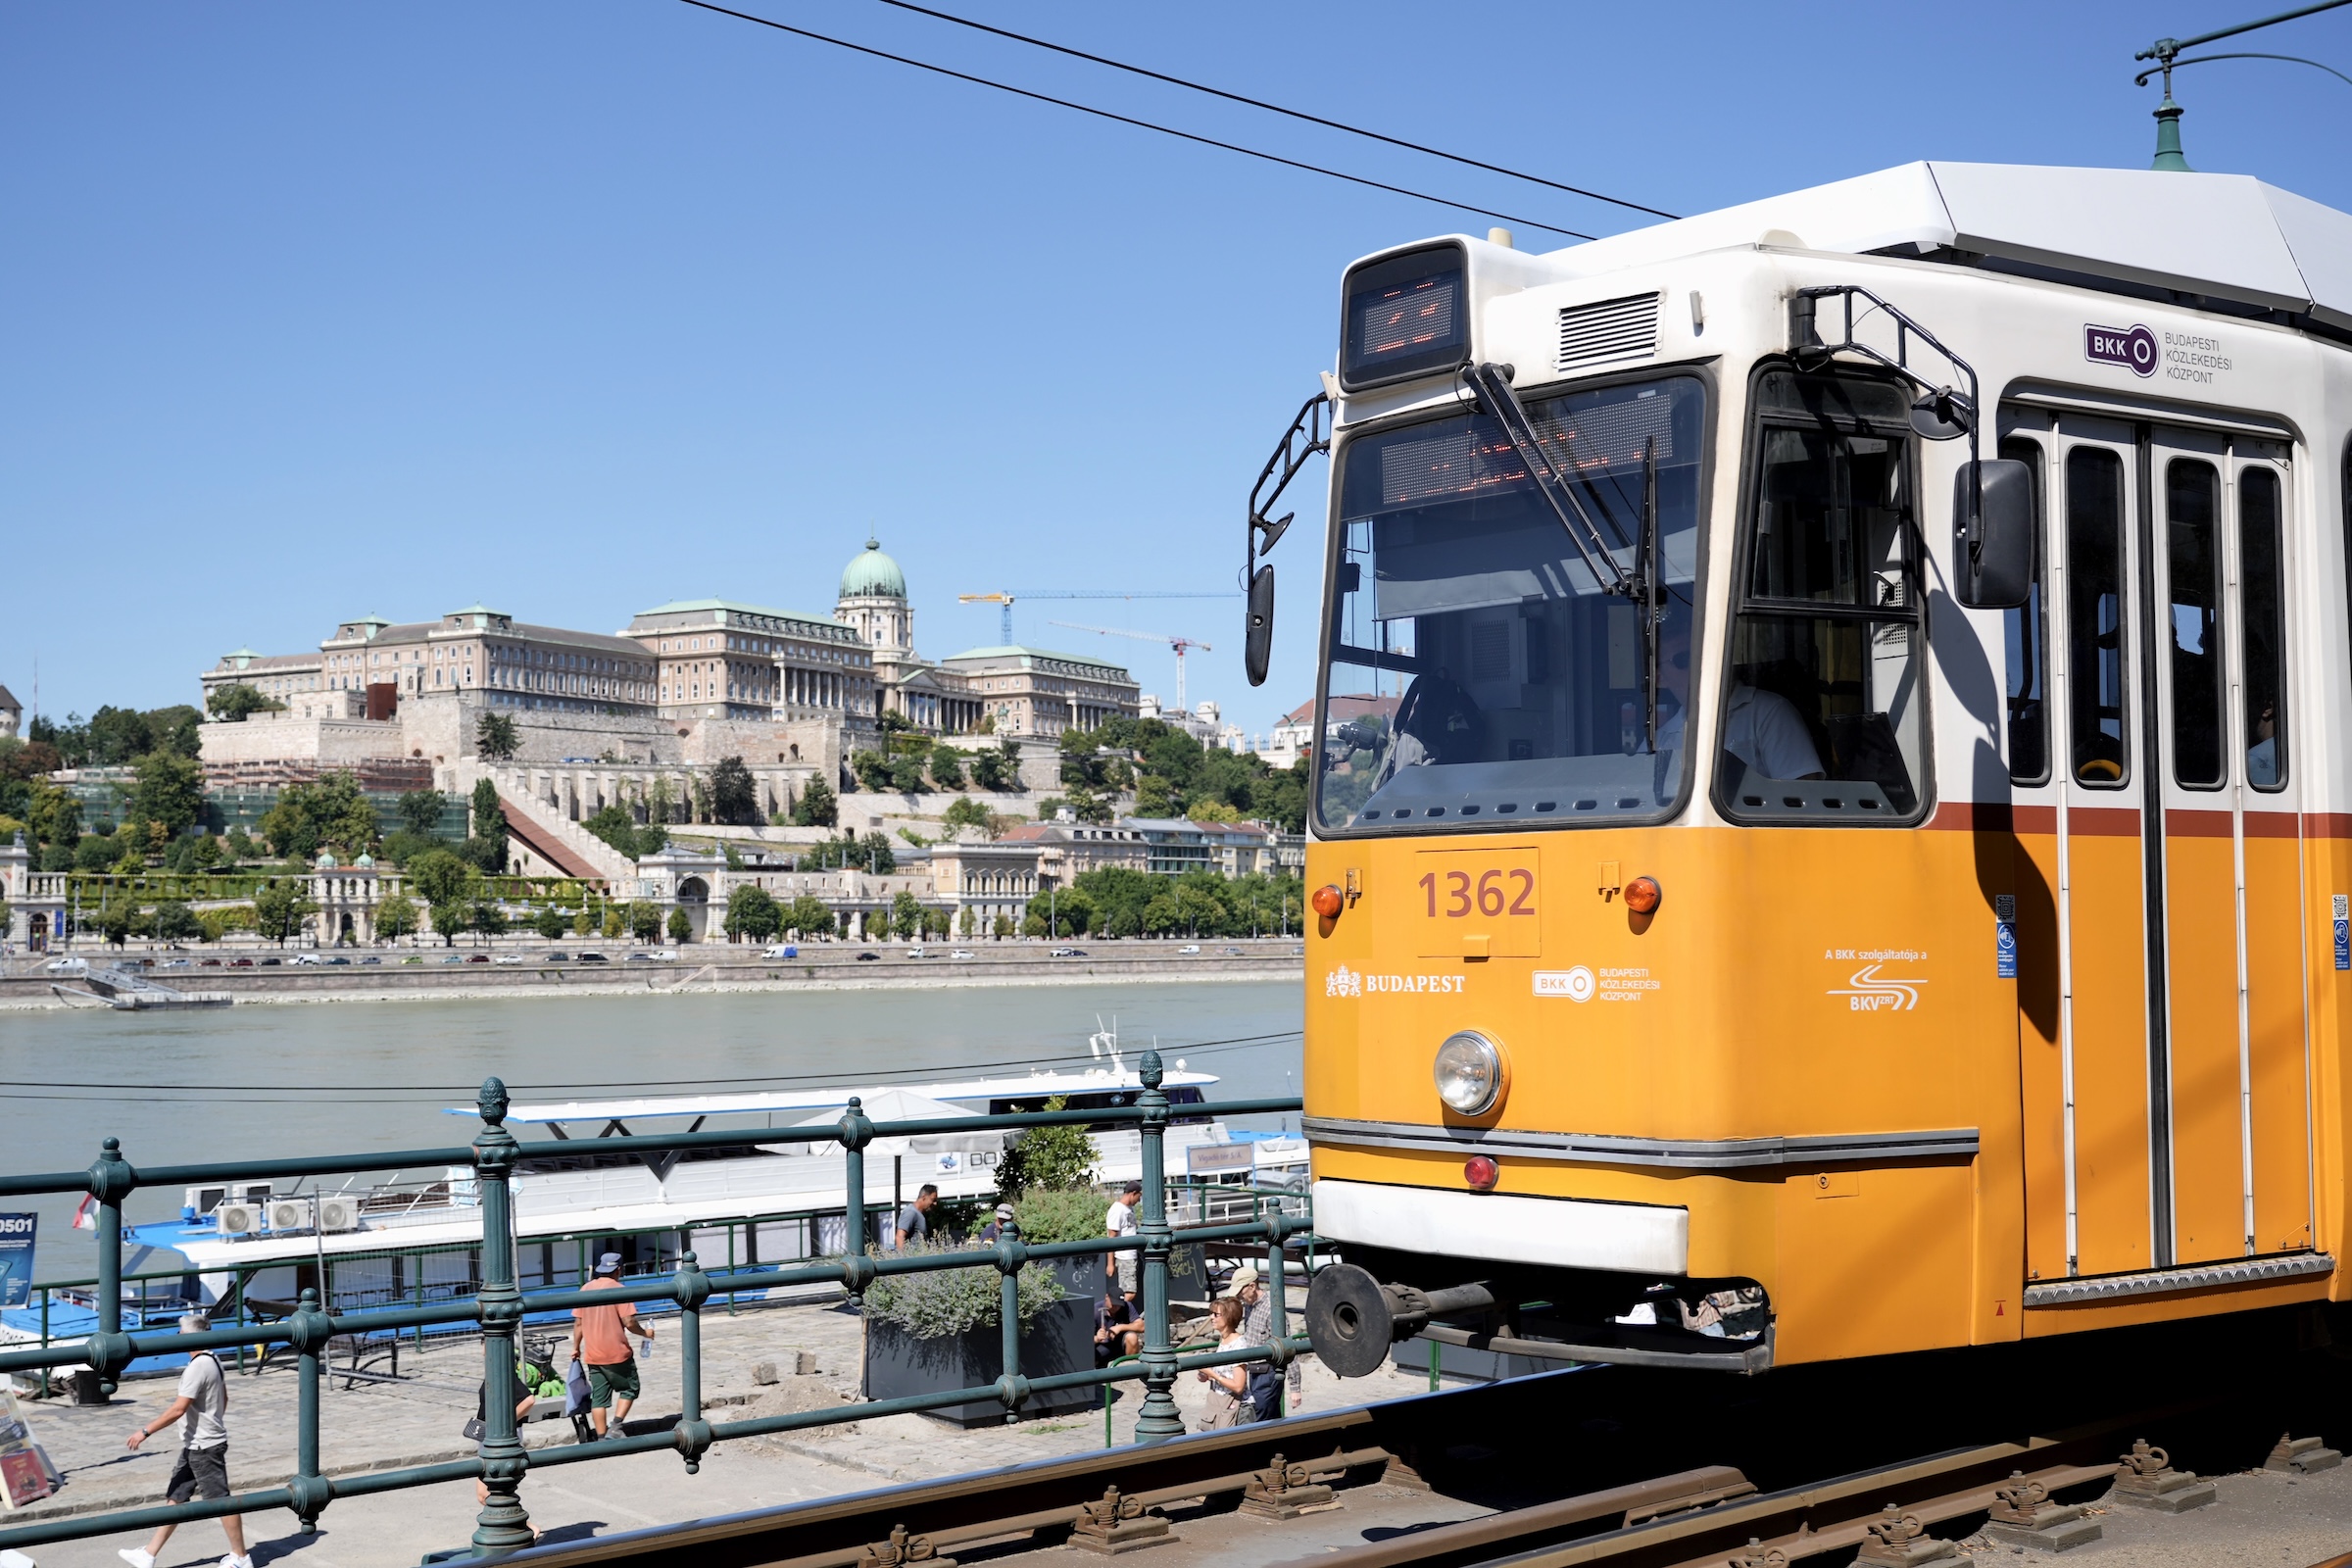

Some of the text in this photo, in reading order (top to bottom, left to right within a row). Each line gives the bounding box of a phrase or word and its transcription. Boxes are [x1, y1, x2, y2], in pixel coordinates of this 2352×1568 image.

[2093, 336, 2127, 357] BKK
[2165, 332, 2220, 352] BUDAPESTI
[2166, 348, 2232, 370] KÖZLEKEDÉSI
[2166, 365, 2213, 384] KÖZPONT
[1418, 868, 1536, 917] 1362
[1825, 949, 1834, 959] A
[1835, 949, 1856, 959] BKK
[1858, 949, 1919, 962] szolgáltatója
[1599, 967, 1649, 978] BUDAPESTI
[1365, 975, 1465, 993] BUDAPEST
[1541, 978, 1566, 990] BKK
[1599, 978, 1660, 990] KÖZLEKEDÉSI
[1599, 990, 1642, 1002] KÖZPONT
